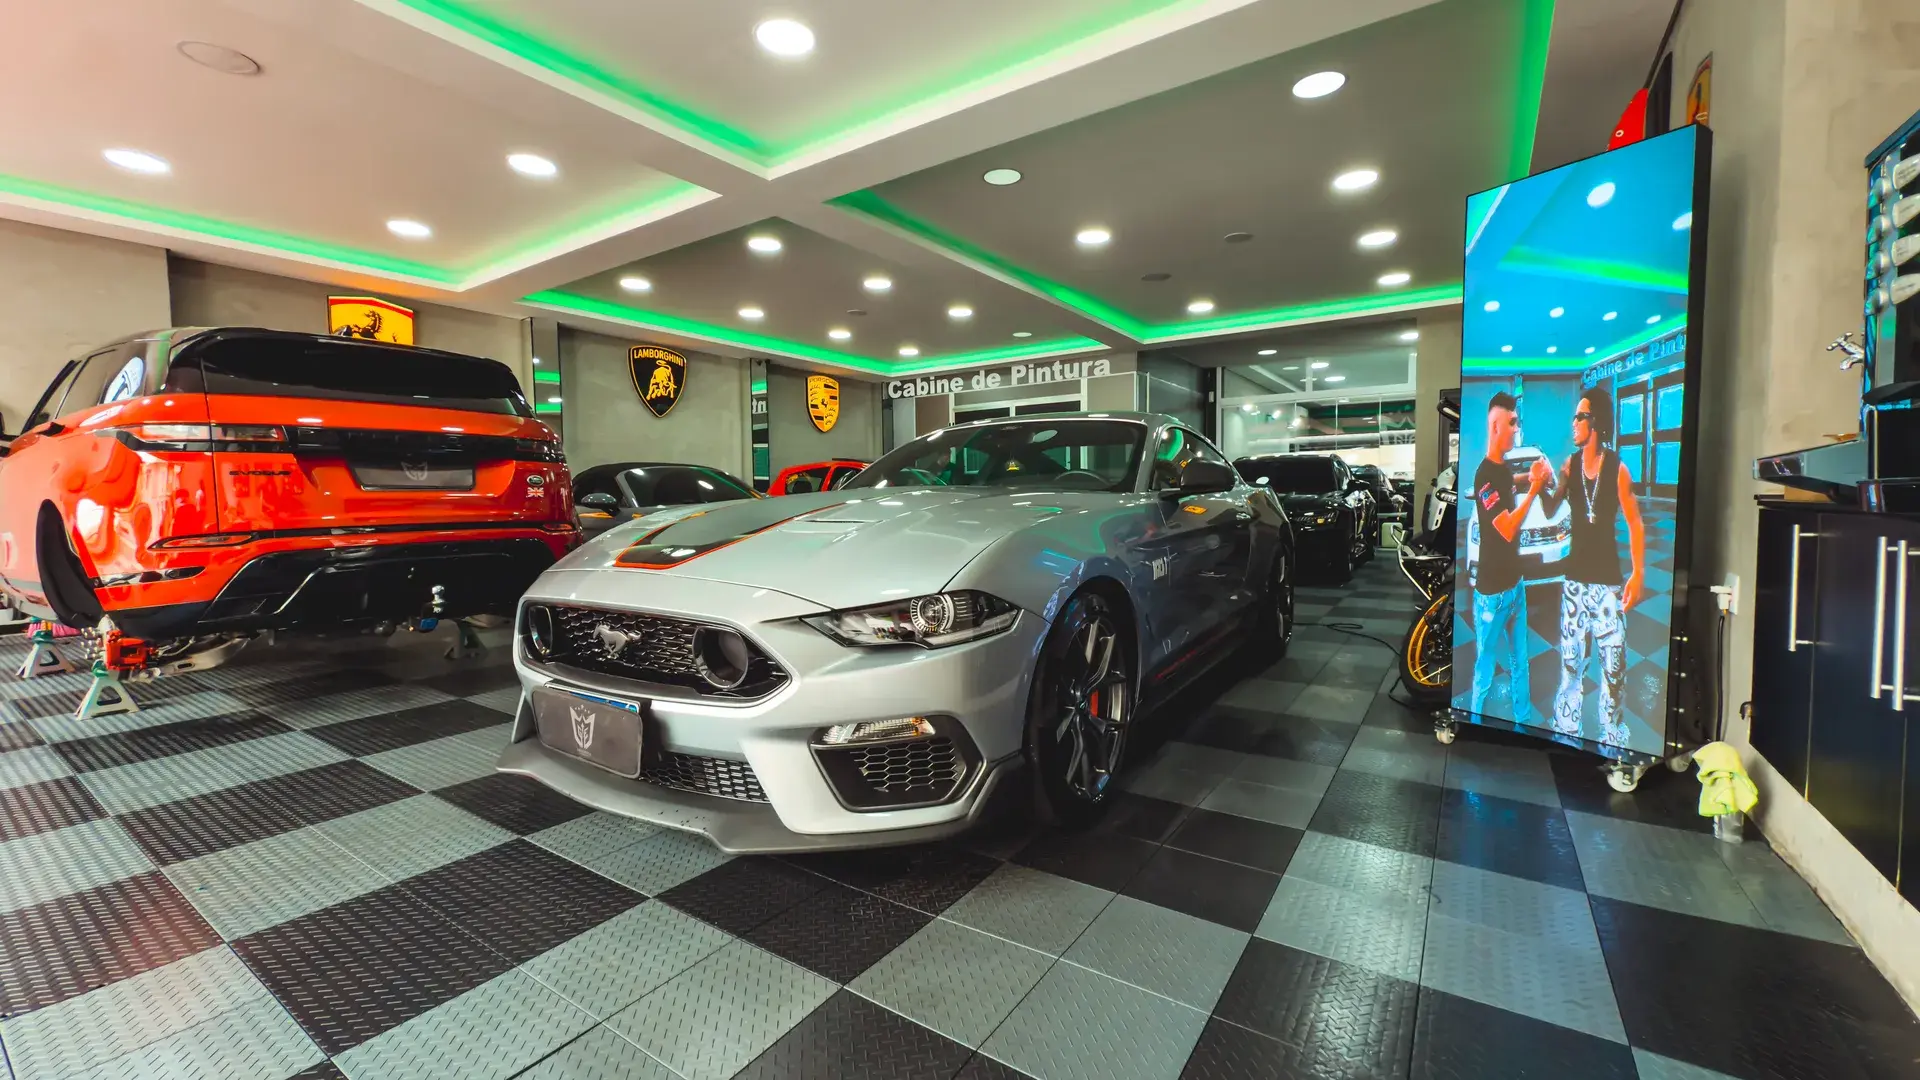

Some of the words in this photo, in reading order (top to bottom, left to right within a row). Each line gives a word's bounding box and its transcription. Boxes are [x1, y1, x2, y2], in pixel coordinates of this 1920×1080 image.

[634, 349, 684, 367] LAMBORGHINI
[888, 375, 963, 399] Cabine
[971, 370, 1001, 391] de
[1011, 358, 1111, 386] Pintura
